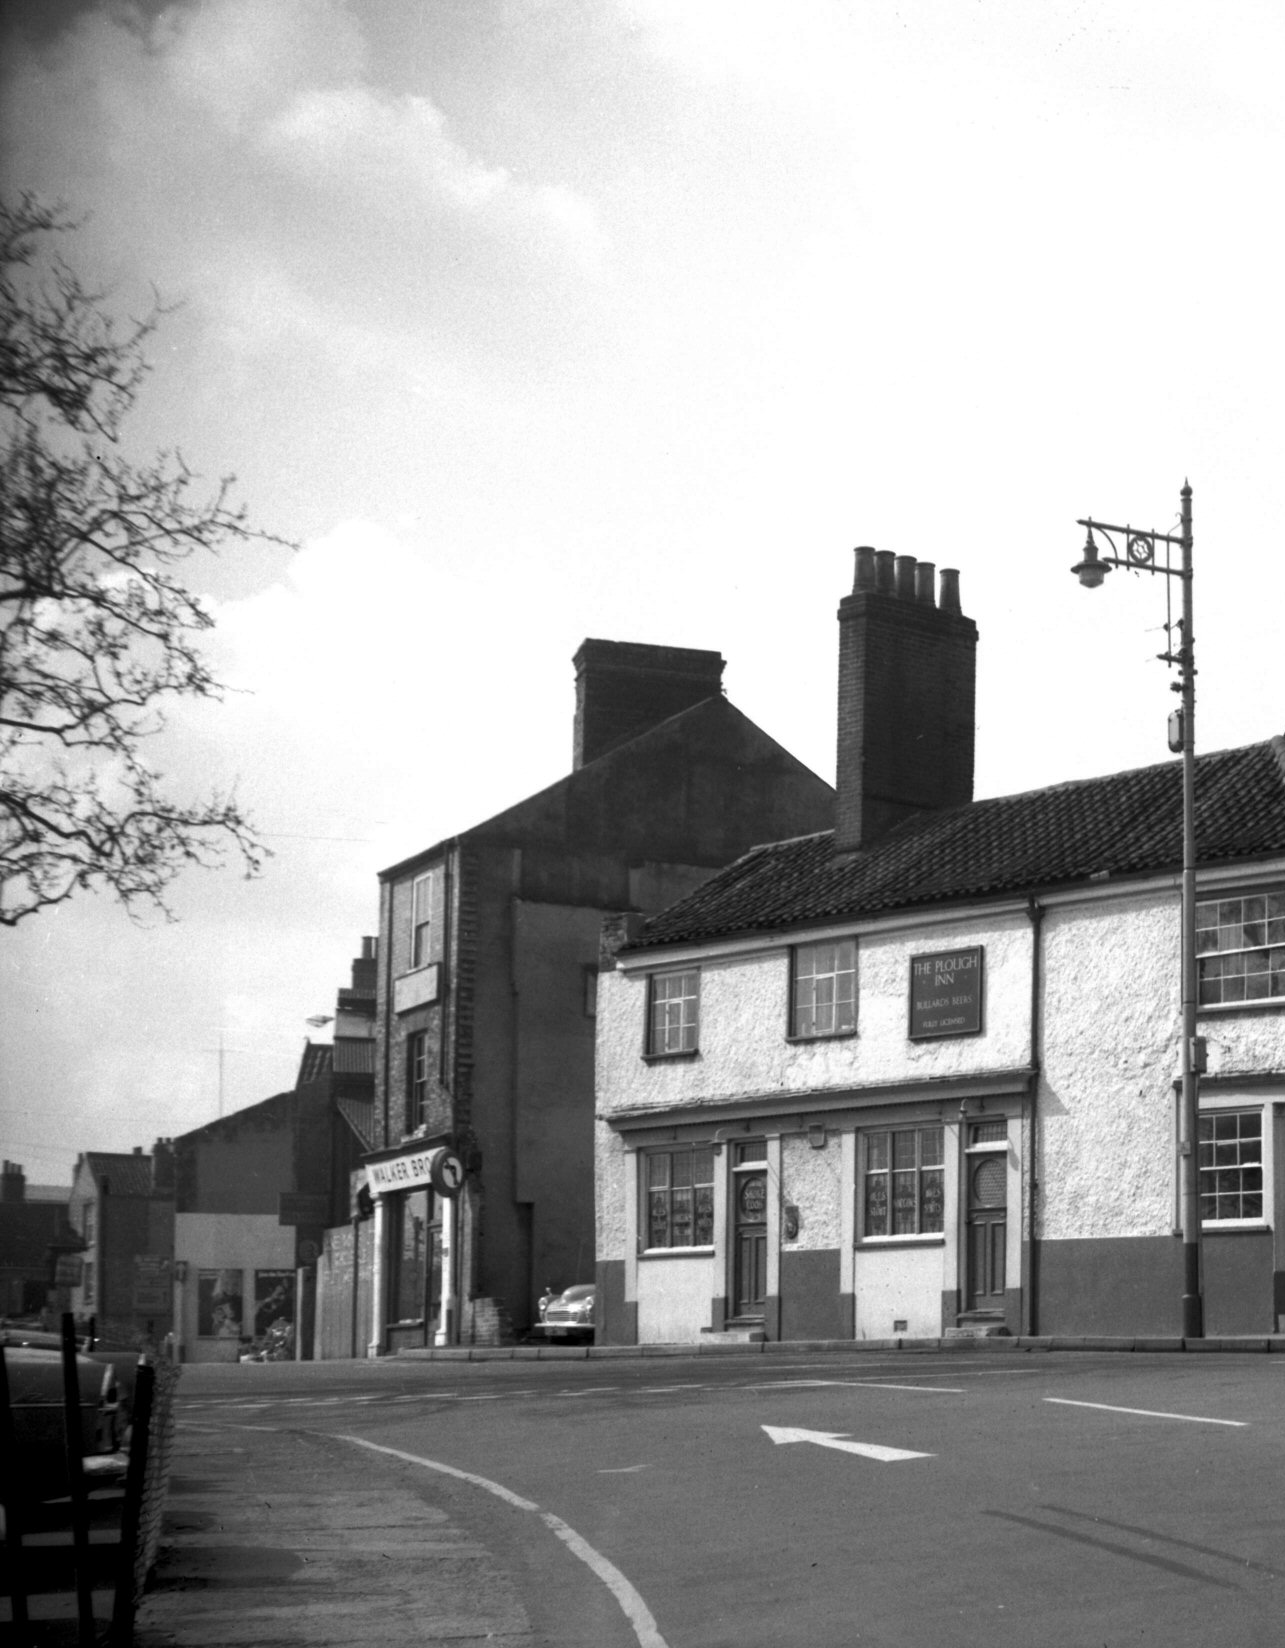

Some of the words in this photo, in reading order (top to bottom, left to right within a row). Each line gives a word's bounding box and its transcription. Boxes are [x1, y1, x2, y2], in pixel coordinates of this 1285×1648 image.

[913, 962, 932, 976] THE
[935, 955, 978, 972] PLOUGH
[935, 973, 955, 986] INN
[917, 998, 950, 1010] BULLARDS
[952, 995, 973, 1006] BEERS
[372, 1161, 410, 1184] WALKER
[411, 1156, 433, 1177] BRO
